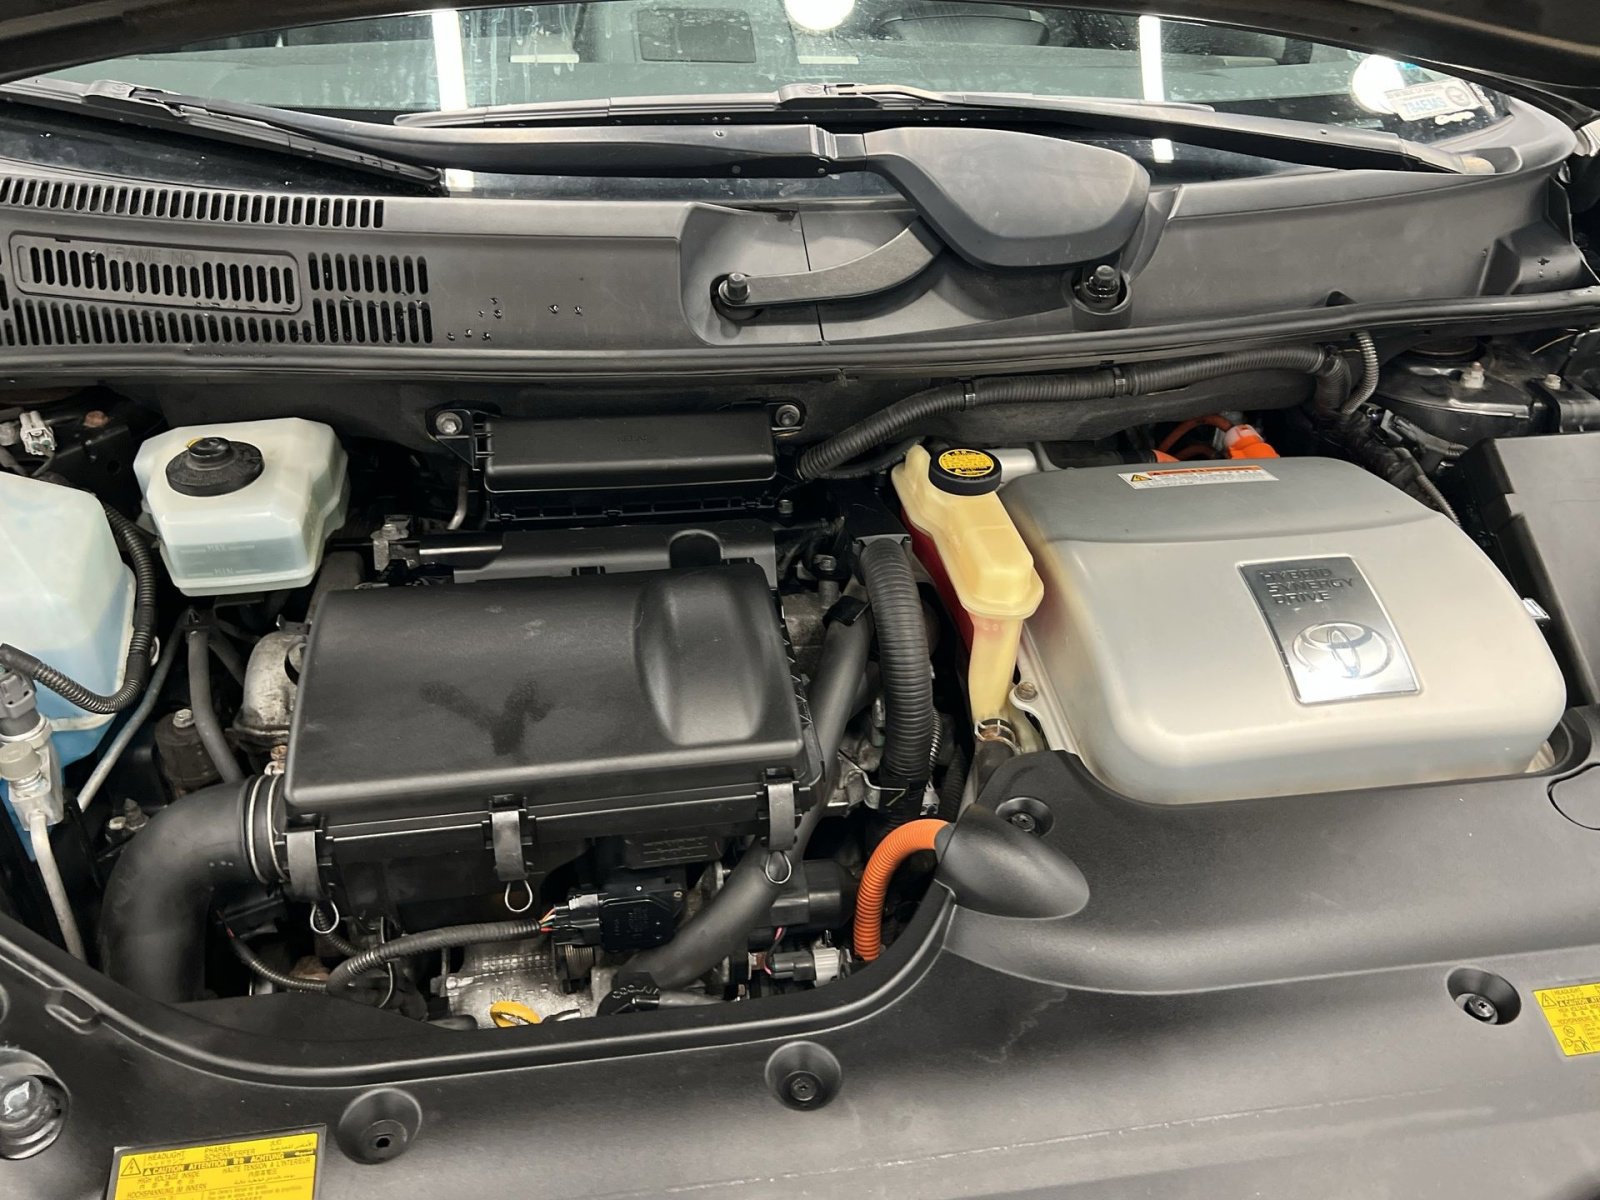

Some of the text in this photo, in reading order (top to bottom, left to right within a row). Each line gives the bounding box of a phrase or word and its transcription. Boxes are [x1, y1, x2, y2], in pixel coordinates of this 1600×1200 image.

[105, 246, 162, 264] FRAME
[207, 544, 227, 553] MAX
[1259, 568, 1333, 581] HYBRID
[1266, 578, 1353, 593] SYNERGY
[1272, 590, 1331, 605] DRIVE
[147, 1151, 185, 1161] HEADLIGHT
[152, 1164, 184, 1175] CAUTION
[188, 1159, 227, 1170] ATTENTION
[250, 1152, 284, 1163] ACHTUNG
[243, 1163, 267, 1172] TENSION
